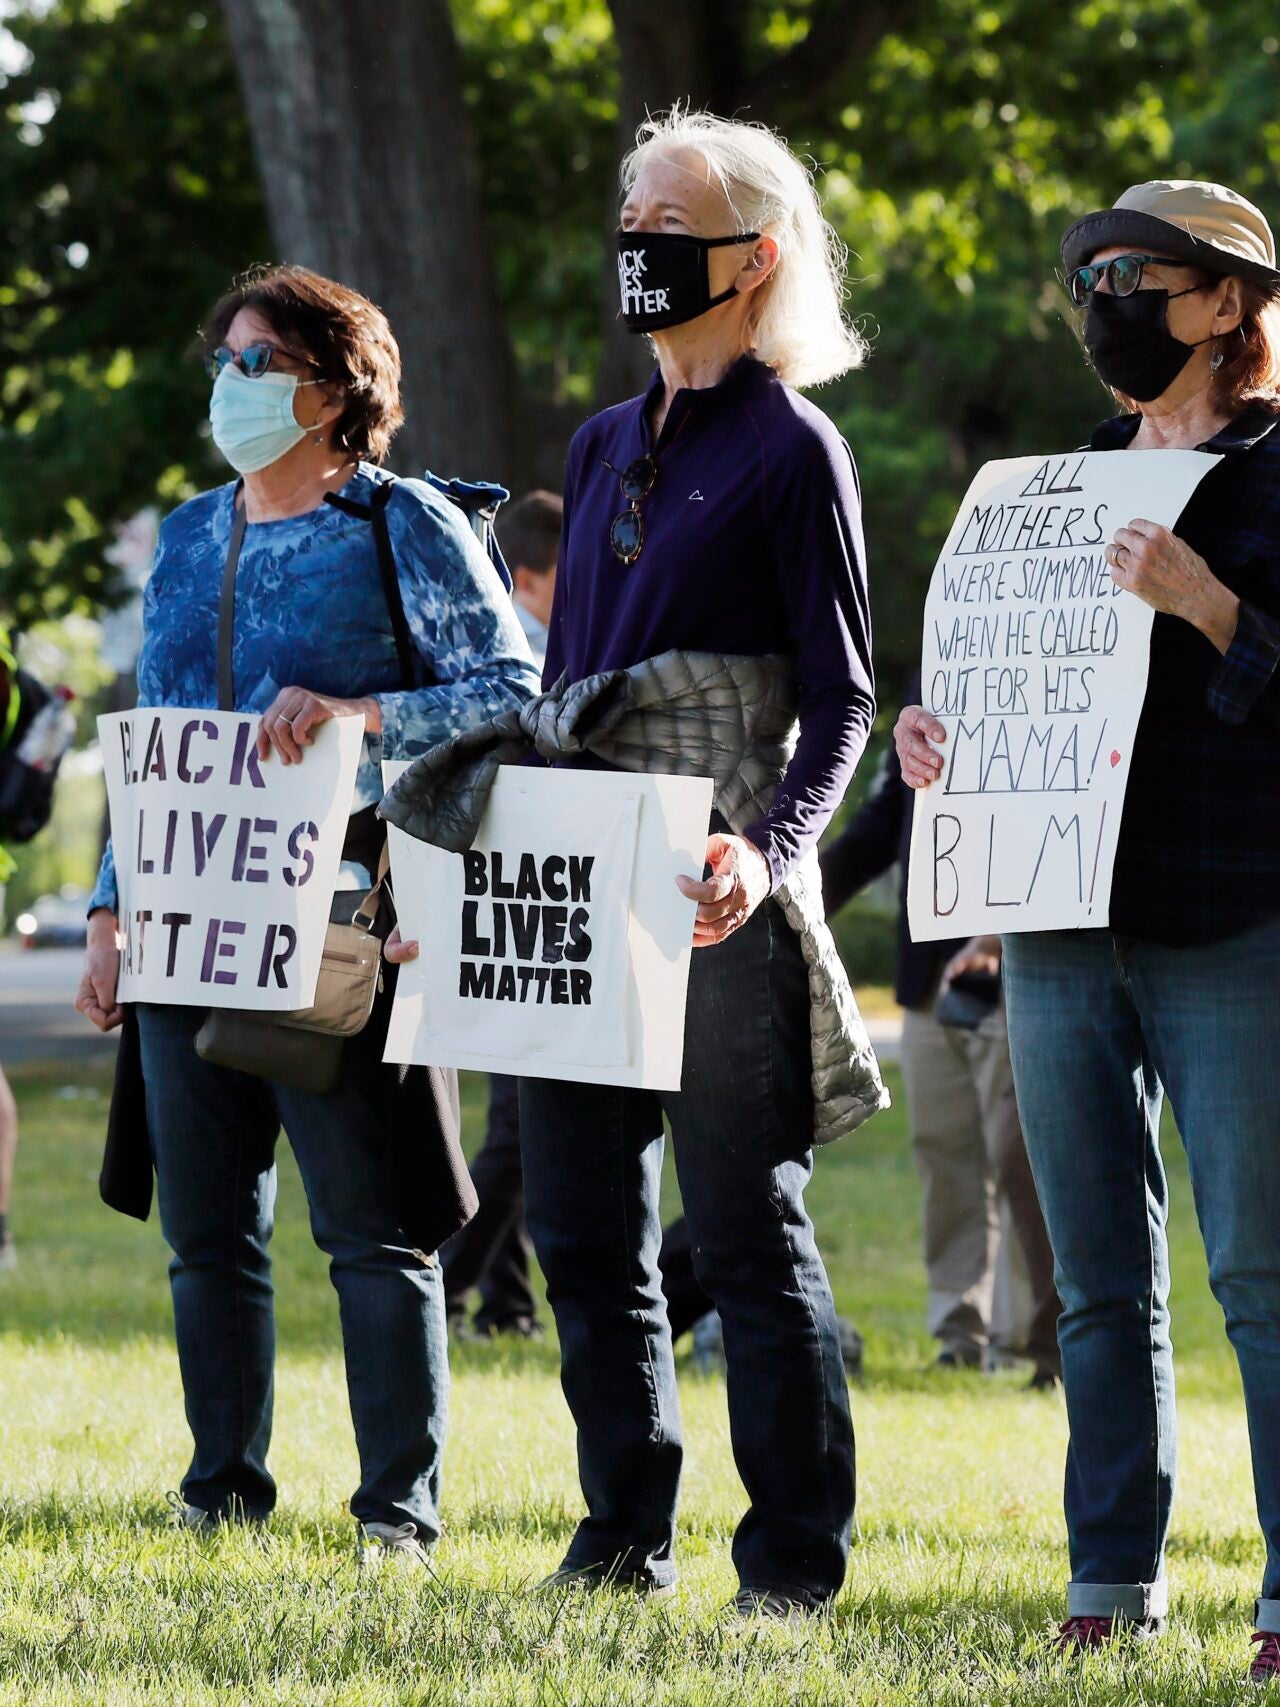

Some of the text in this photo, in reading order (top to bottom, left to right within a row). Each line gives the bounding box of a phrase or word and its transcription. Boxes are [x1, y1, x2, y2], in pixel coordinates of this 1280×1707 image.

[1021, 456, 1086, 496] ALL
[954, 504, 1108, 553] MOTHERS
[942, 559, 1006, 603] WERE
[934, 605, 1118, 661] WHEN HE CALLED
[931, 665, 1095, 716] OUT FOR HIS
[944, 718, 1107, 794] MAMA!
[137, 808, 319, 887] LIVES
[463, 849, 595, 902] BLACK
[123, 908, 297, 989] ATTER
[461, 900, 592, 964] LIVES
[459, 961, 593, 1005] MATTER
